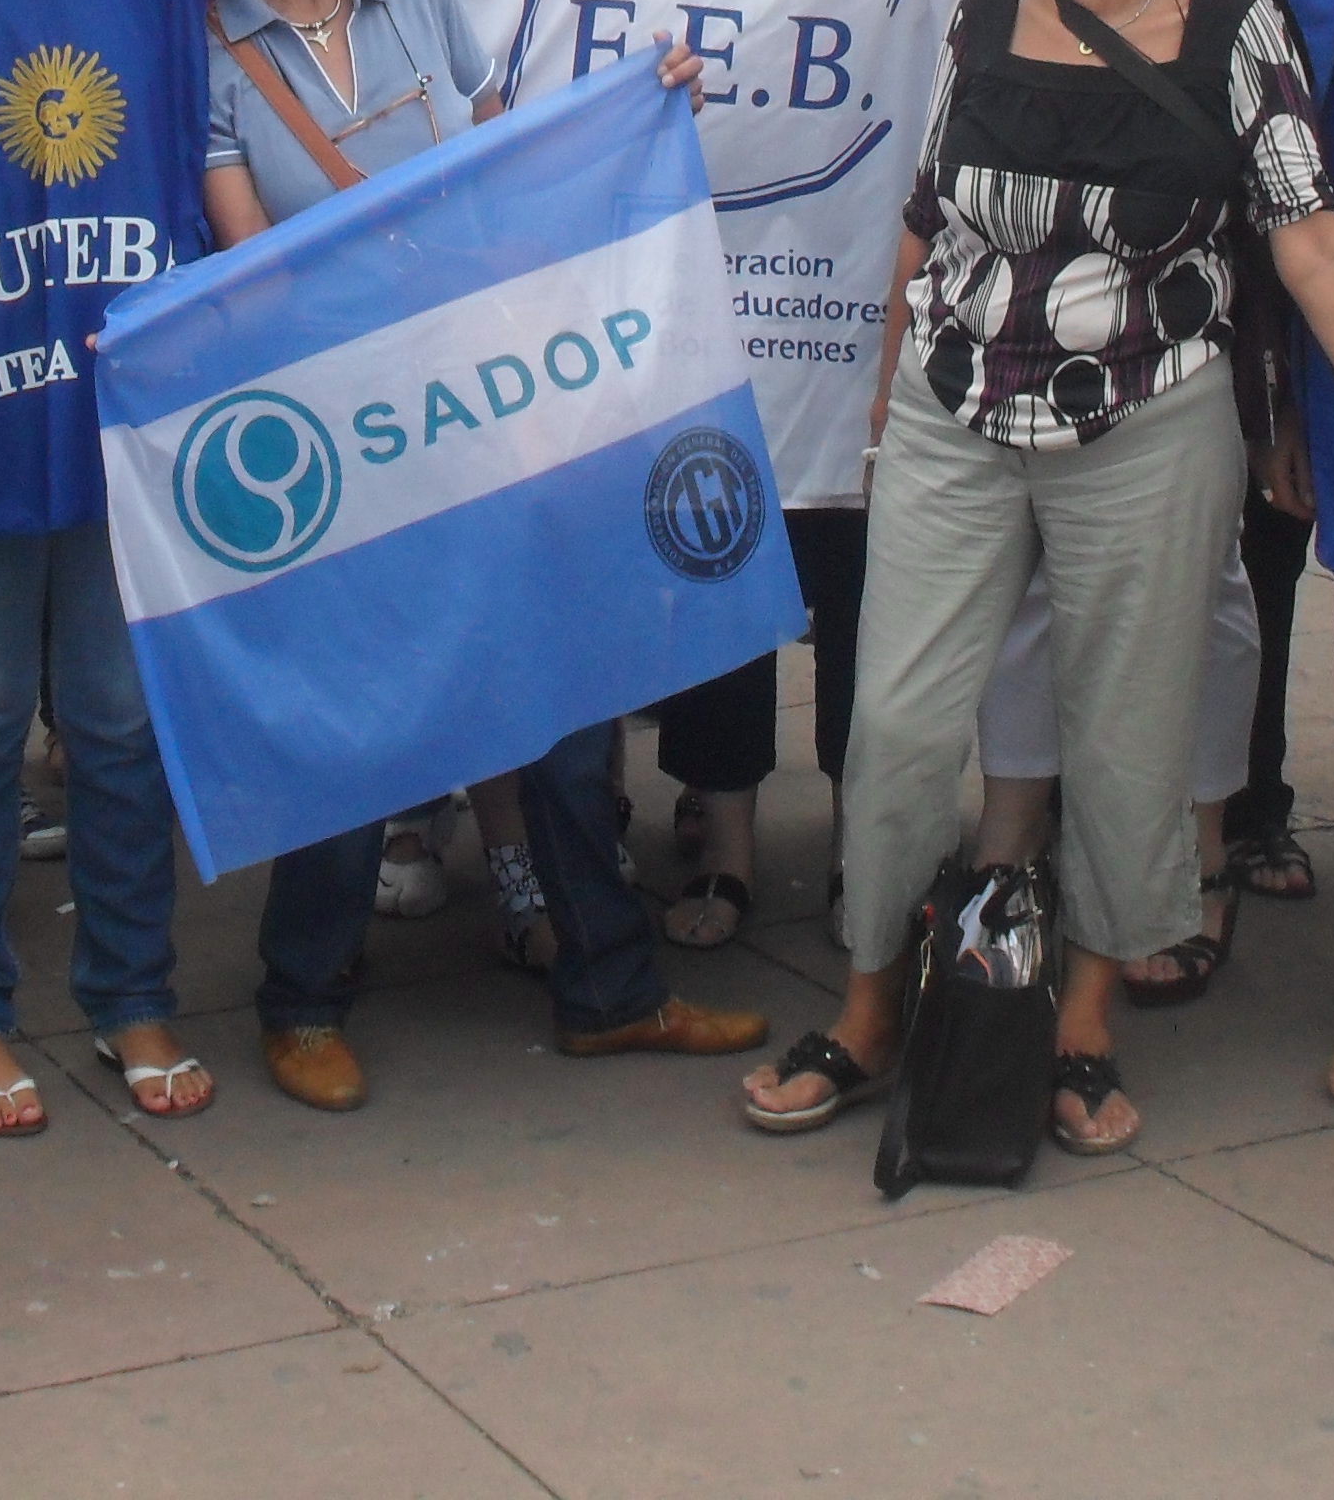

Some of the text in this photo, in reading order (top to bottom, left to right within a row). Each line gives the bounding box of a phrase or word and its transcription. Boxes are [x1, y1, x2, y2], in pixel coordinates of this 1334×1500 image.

[723, 248, 834, 278] eracion
[732, 290, 888, 323] ducadore
[741, 336, 858, 363] erenses
[352, 308, 657, 466] SADOP
